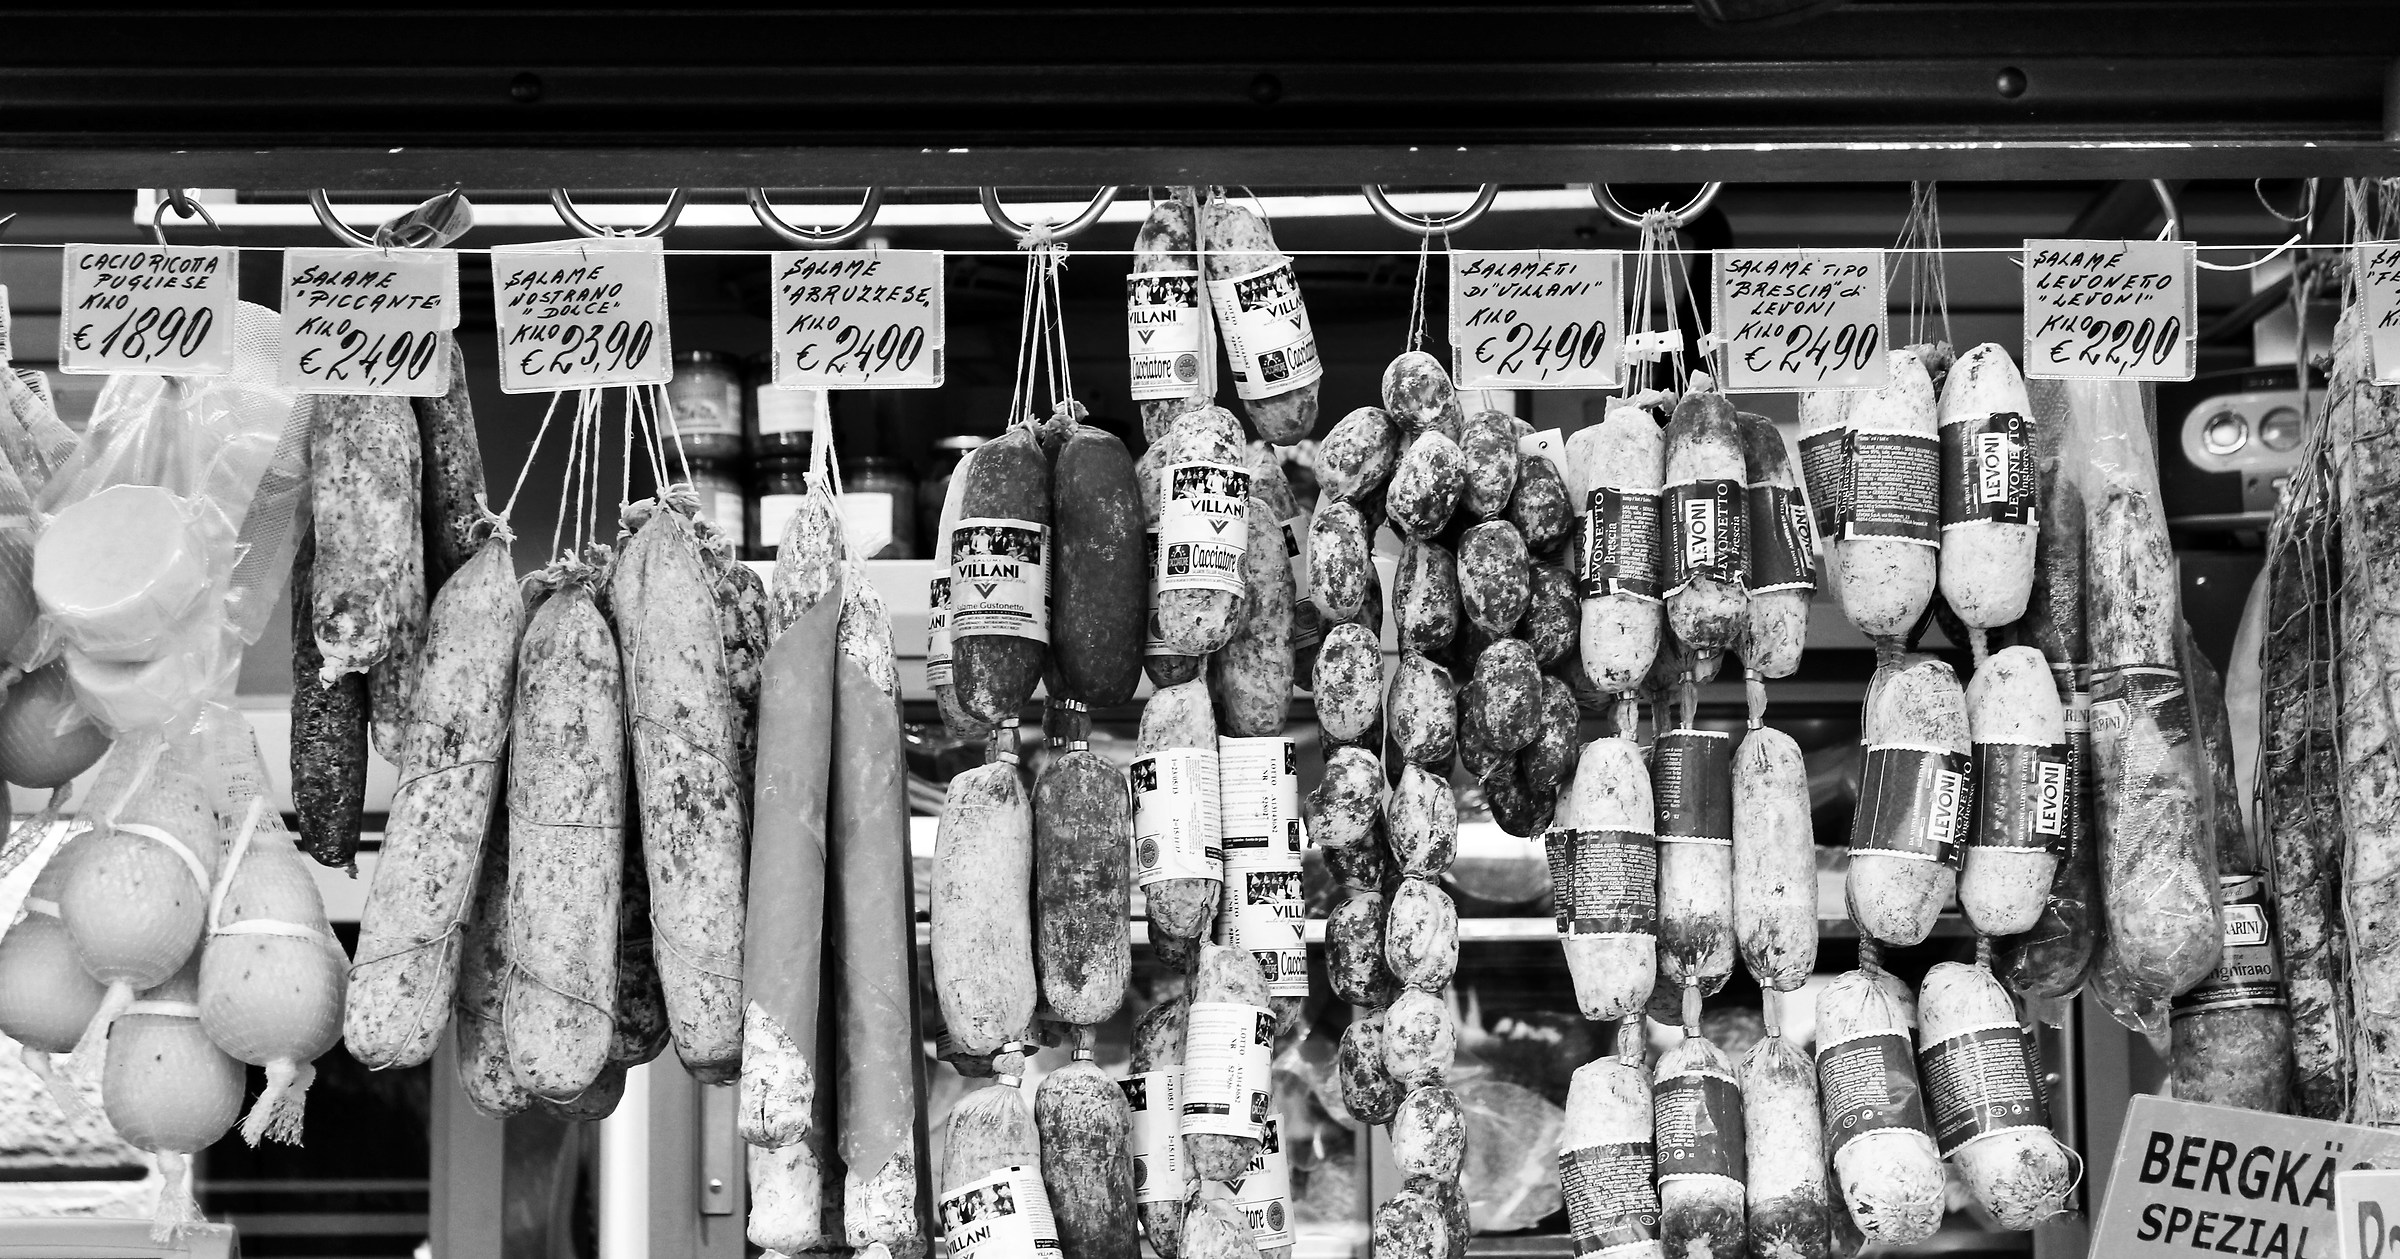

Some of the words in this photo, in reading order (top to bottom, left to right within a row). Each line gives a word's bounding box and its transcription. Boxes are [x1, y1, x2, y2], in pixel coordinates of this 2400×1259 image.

[780, 256, 882, 281] SALAME
[1725, 259, 1813, 279] SALAME
[1822, 263, 1868, 278] TIPO
[2032, 250, 2124, 272] SALAME
[93, 274, 210, 292] PUGLIESE
[291, 264, 397, 289] SALAME
[504, 265, 605, 290] SALAME
[79, 292, 129, 310] KILO
[508, 282, 623, 308] NOSTRANO
[1750, 301, 1835, 317] LEVONI
[295, 316, 352, 337] KILO
[786, 314, 840, 335] KILO
[1465, 306, 1517, 327] KILO
[1733, 320, 1784, 341] KILO
[2035, 314, 2094, 338] KILO
[73, 323, 94, 350] €
[100, 306, 213, 363] 18,90
[509, 323, 561, 346] KILO
[520, 349, 545, 376] €
[549, 320, 653, 375] 23,90
[2050, 339, 2073, 363] €
[2078, 315, 2181, 377] 22,90
[299, 348, 323, 374] €
[325, 328, 437, 387] 24,90
[796, 343, 820, 371] €
[824, 323, 925, 383] 24,90
[1475, 336, 1497, 363] €
[1496, 320, 1606, 380] 24,90
[1744, 346, 1772, 372] €
[1779, 323, 1879, 382] 24,90
[1984, 437, 2001, 498] LEVONI
[2004, 418, 2020, 518] LEVONETO
[1190, 499, 1245, 518] VILLANI
[1589, 492, 1604, 596] LEVONETTO
[1603, 522, 1617, 564] Brescia
[1691, 503, 1707, 564] LEVONI
[958, 563, 1019, 579] VILLANI
[1192, 543, 1237, 573] Cacciatore
[979, 601, 1024, 611] Gustonetto
[1933, 774, 1956, 838] LEVONI
[1948, 761, 1972, 862] LEVONETTO
[2042, 766, 2059, 830] LEVONI
[1239, 1027, 1247, 1056] LOTTO
[2138, 1131, 2377, 1211] BERGKÄ
[946, 1225, 991, 1255] VILLANI
[2136, 1203, 2312, 1259] SPEZIAL
